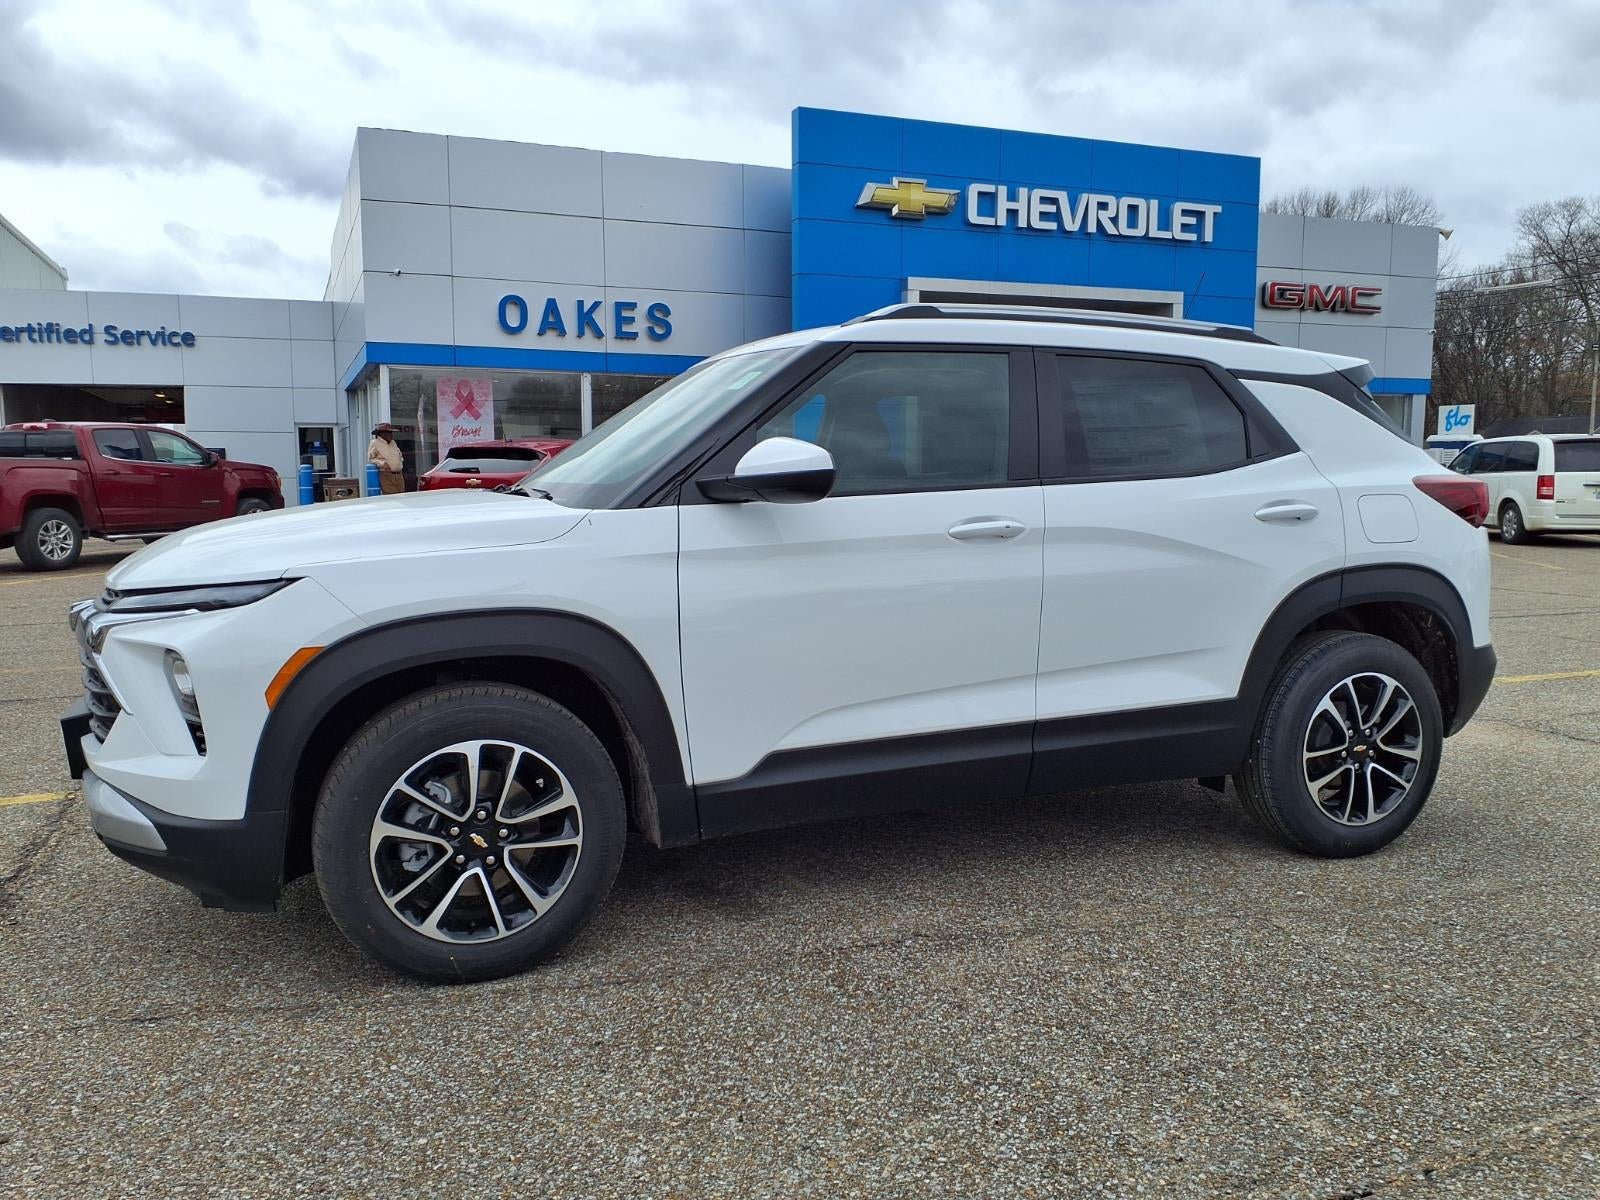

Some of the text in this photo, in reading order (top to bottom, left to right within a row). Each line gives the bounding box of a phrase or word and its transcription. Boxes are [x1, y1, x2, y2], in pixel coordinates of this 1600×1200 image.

[968, 183, 1222, 242] CHEVROLET
[1262, 281, 1382, 313] GMC
[498, 294, 673, 341] OAKES
[0, 322, 196, 347] ertified Service
[451, 424, 482, 438] Breast
[1445, 405, 1472, 432] flo
